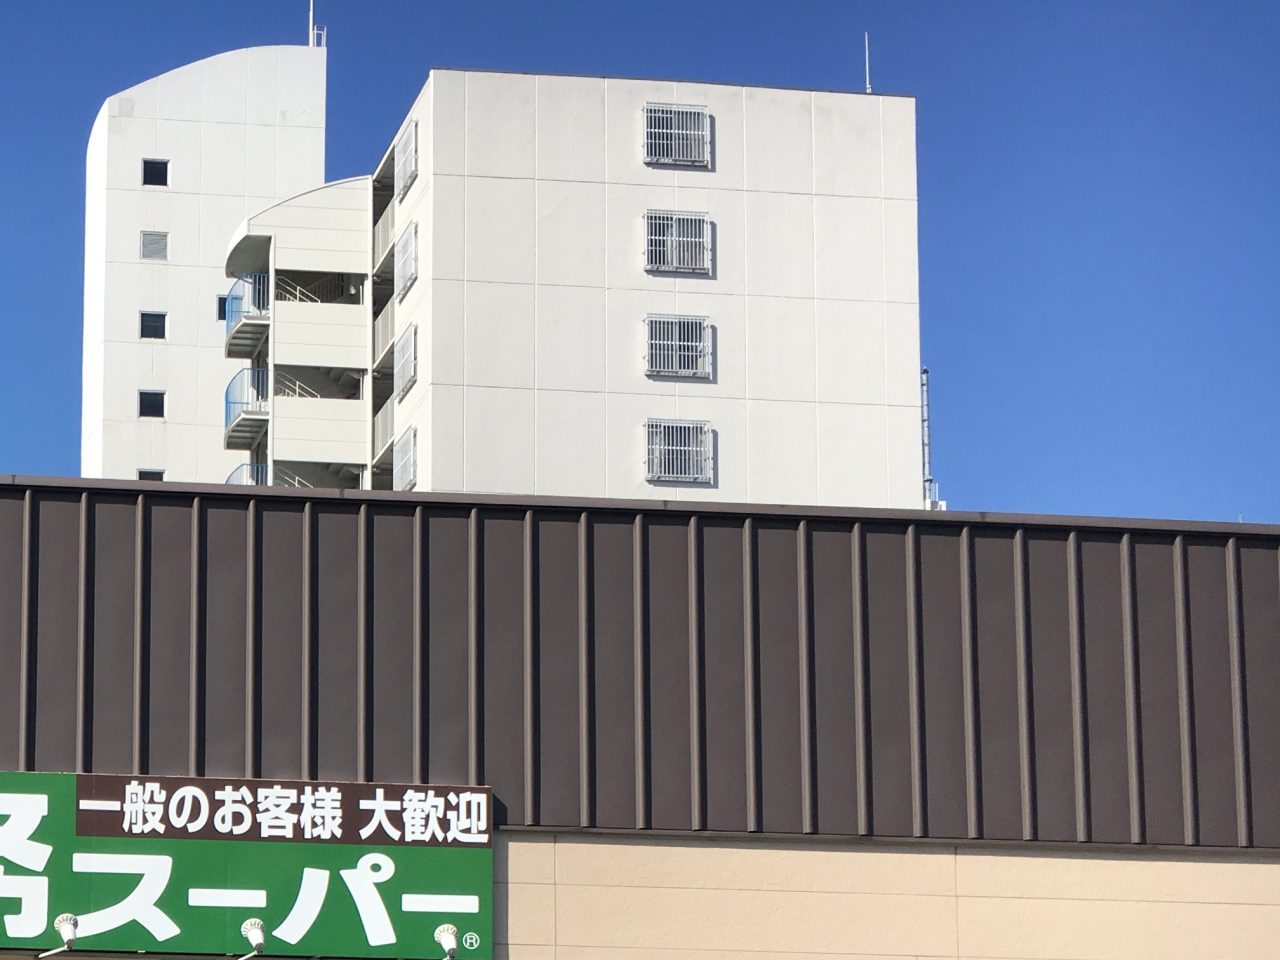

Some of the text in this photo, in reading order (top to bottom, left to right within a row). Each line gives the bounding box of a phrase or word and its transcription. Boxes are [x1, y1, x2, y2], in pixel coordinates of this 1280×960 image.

[78, 780, 489, 844] 一般のお客様 大歓迎
